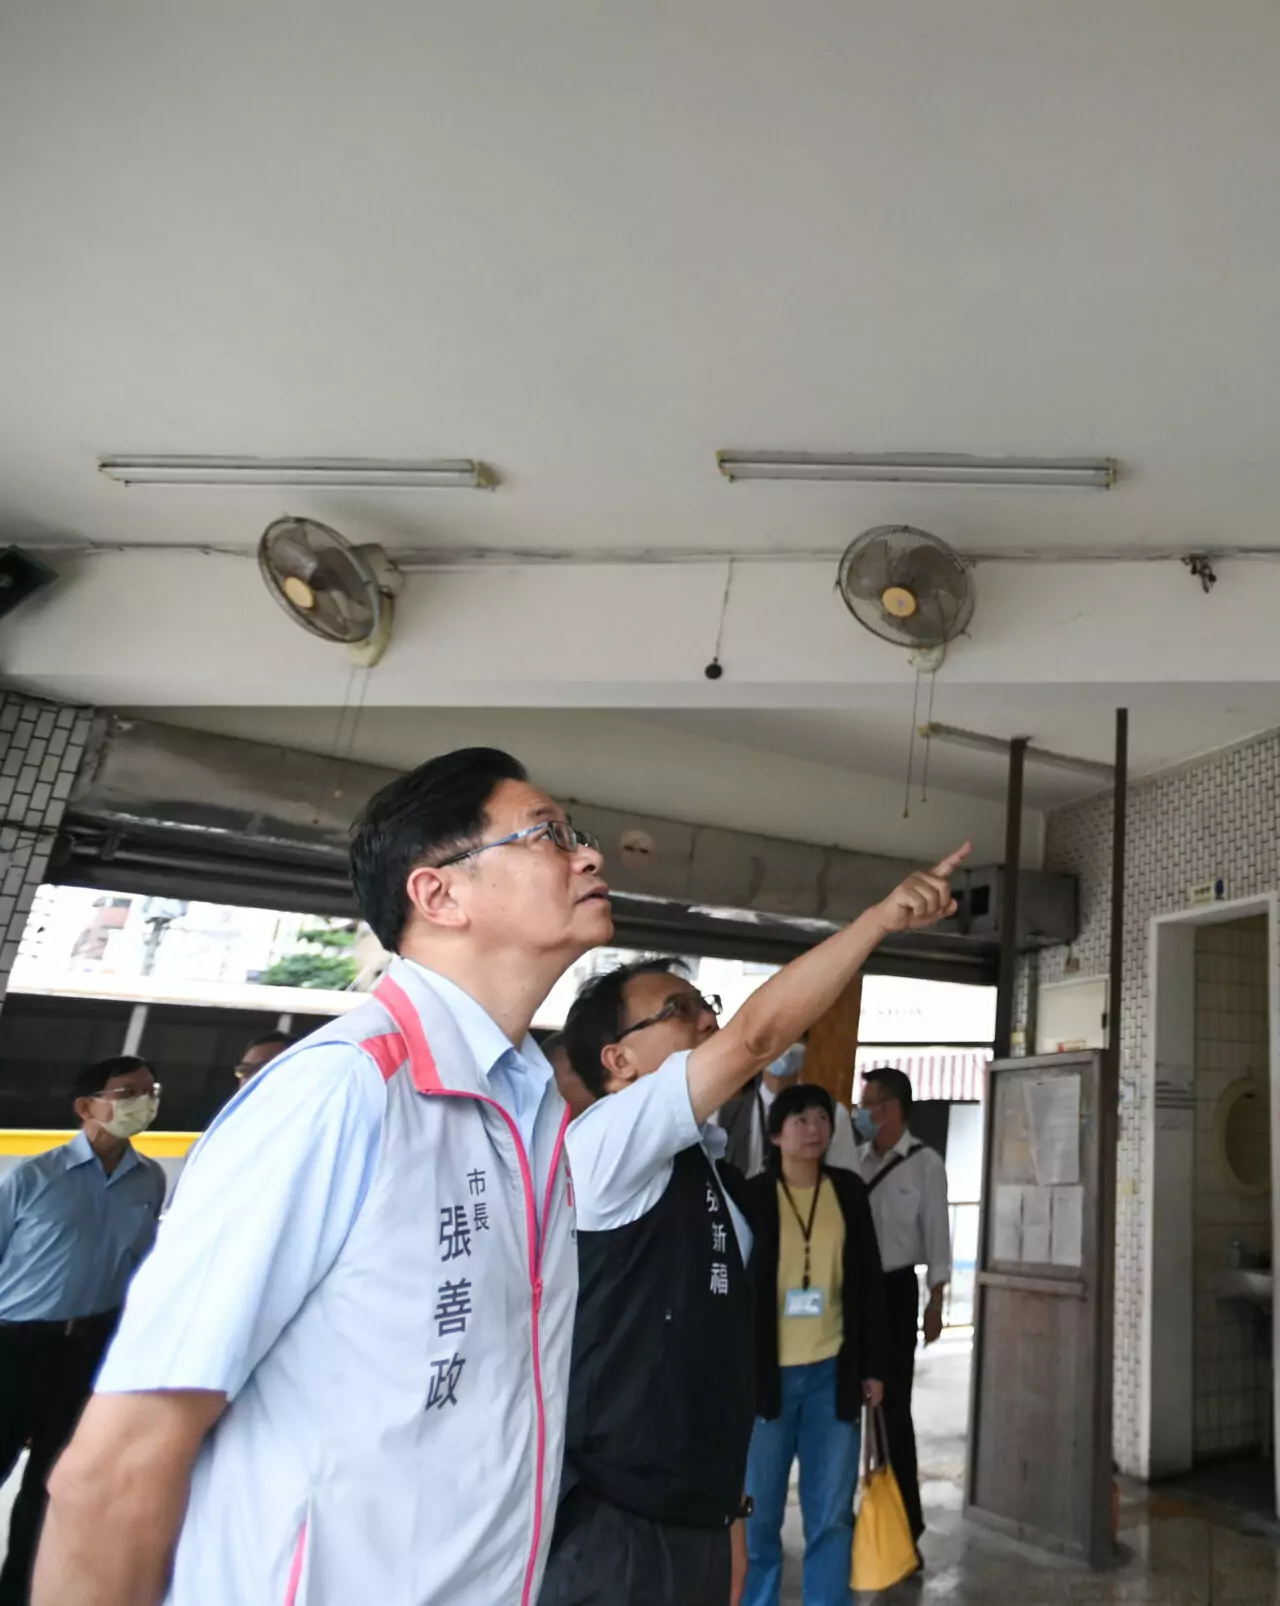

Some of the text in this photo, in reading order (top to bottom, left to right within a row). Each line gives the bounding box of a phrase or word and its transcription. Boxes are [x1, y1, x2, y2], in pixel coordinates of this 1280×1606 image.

[466, 1168, 491, 1232] 市長
[424, 1205, 474, 1413] 張善政
